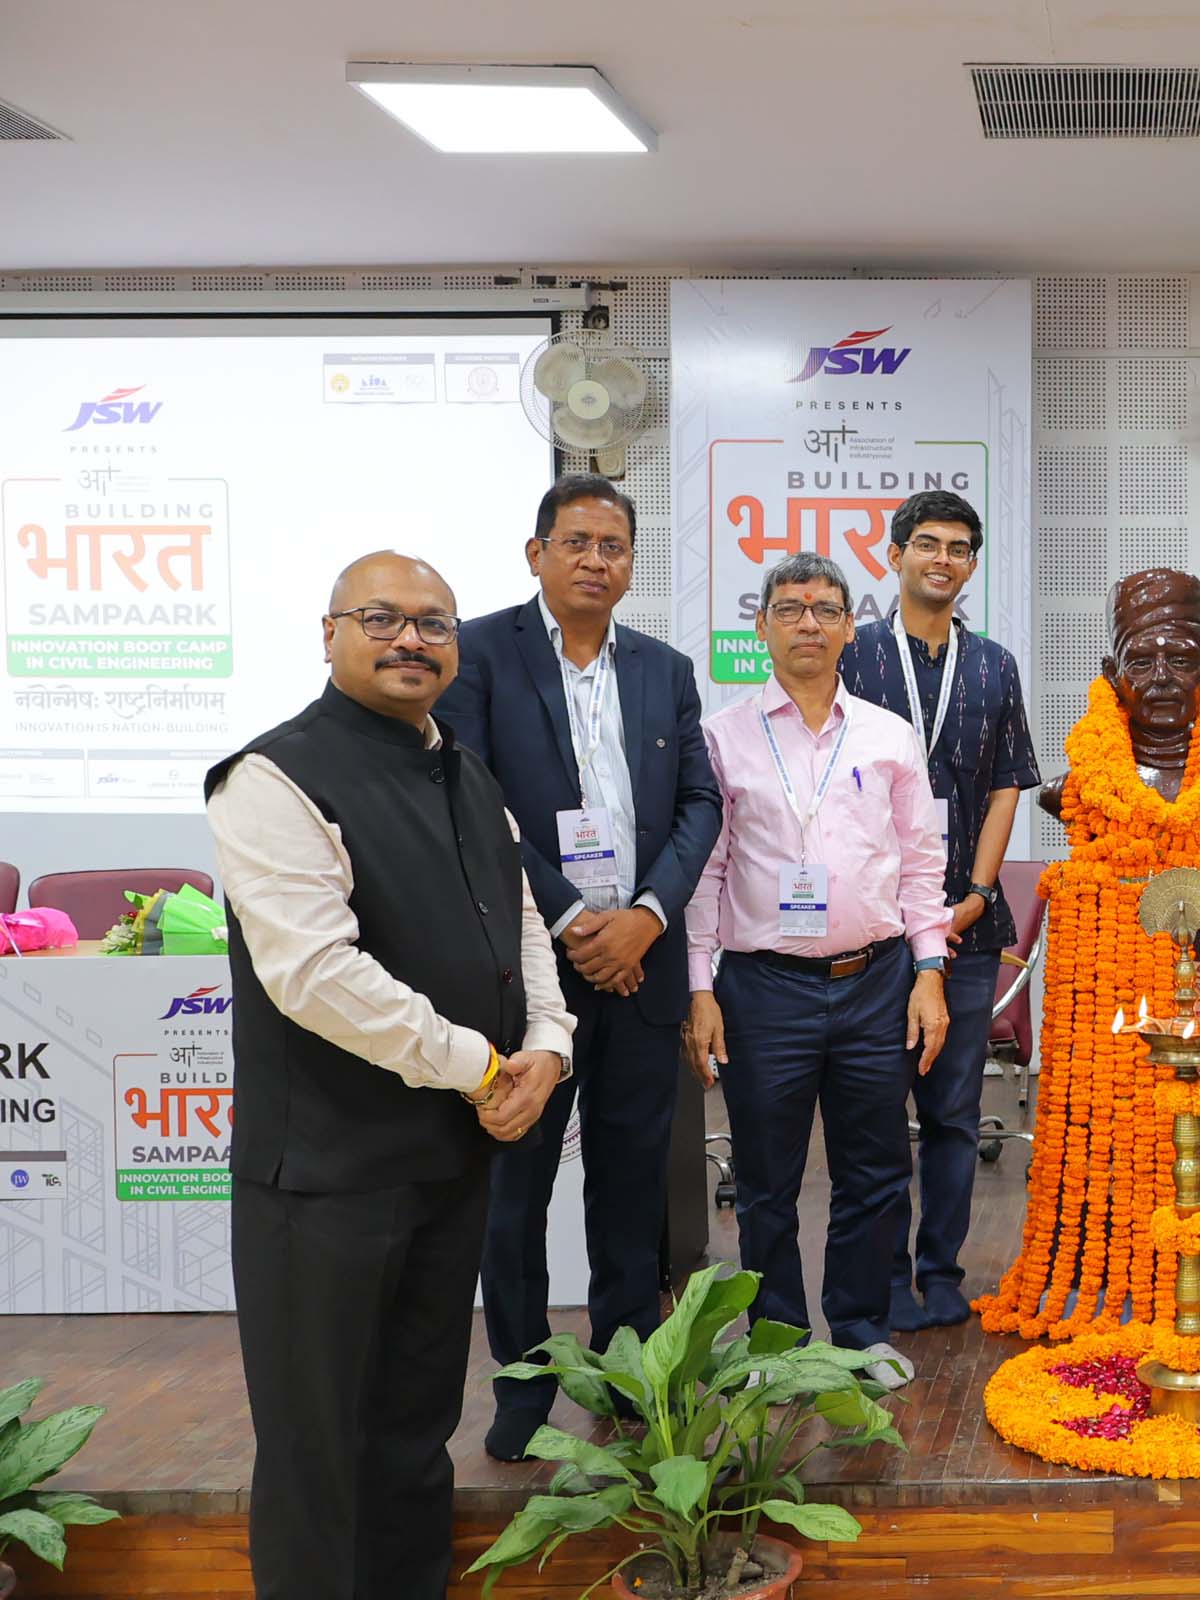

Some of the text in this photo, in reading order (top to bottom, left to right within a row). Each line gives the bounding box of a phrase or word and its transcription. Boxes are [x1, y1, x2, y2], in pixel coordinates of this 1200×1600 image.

[785, 347, 912, 383] JSW
[796, 401, 903, 411] PRESENTS
[61, 401, 164, 432] JSW
[70, 445, 158, 454] PRESENTS
[787, 471, 970, 490] BUILDING
[65, 503, 214, 519] BUILDING
[727, 495, 907, 581] भार
[17, 523, 212, 593] भारत
[28, 603, 217, 626] SAMPAARK
[11, 640, 227, 654] INNOVATION BOOT CAMP
[26, 656, 214, 671] IN CIVIL ENGINEERING
[734, 658, 755, 674] IN
[15, 721, 94, 734] INNOVATION
[96, 722, 109, 734] IS
[157, 997, 234, 1020] JSW
[160, 1072, 228, 1084] BUILD
[124, 1087, 235, 1138] भार
[132, 1145, 232, 1163] SAMPAA
[119, 1173, 233, 1184] INNOVATION BOO
[130, 1184, 232, 1196] IN CIVIL ENGINE
